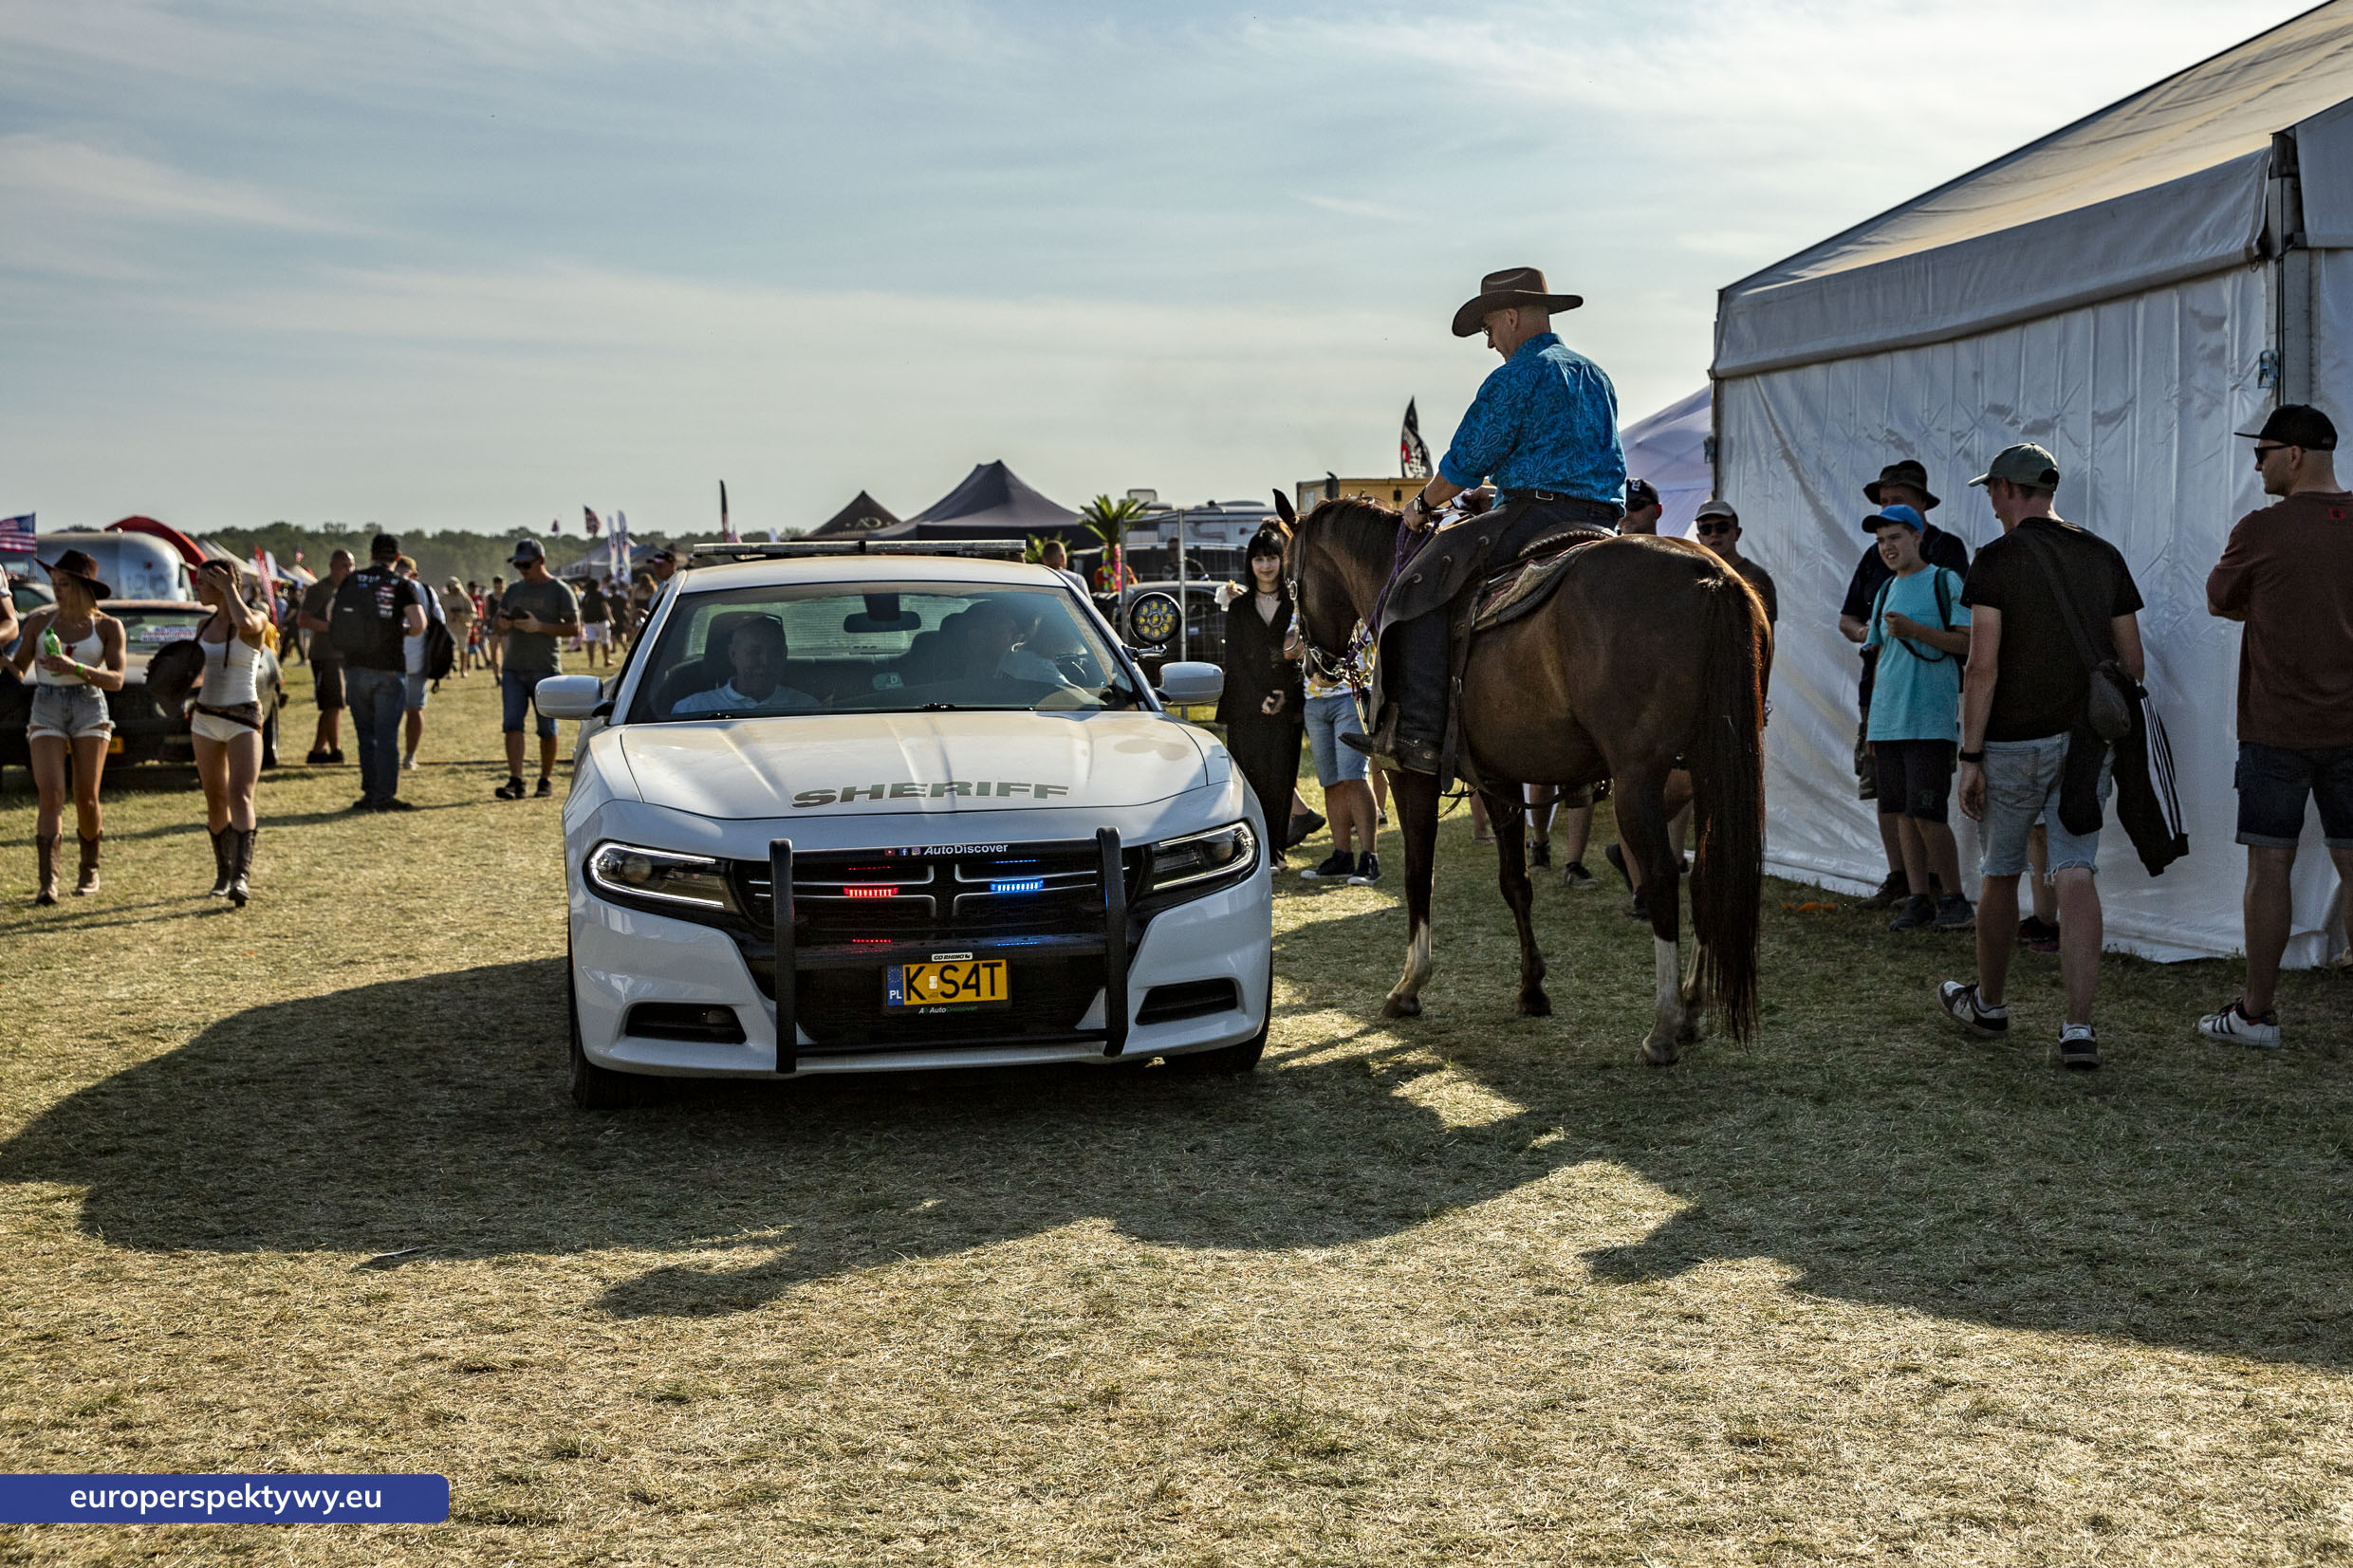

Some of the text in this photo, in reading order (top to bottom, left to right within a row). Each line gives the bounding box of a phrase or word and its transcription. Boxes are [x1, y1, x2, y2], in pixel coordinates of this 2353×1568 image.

[791, 781, 1069, 808] SHERIFF
[923, 844, 1009, 856] AutoDiscover
[889, 989, 902, 1000] PL
